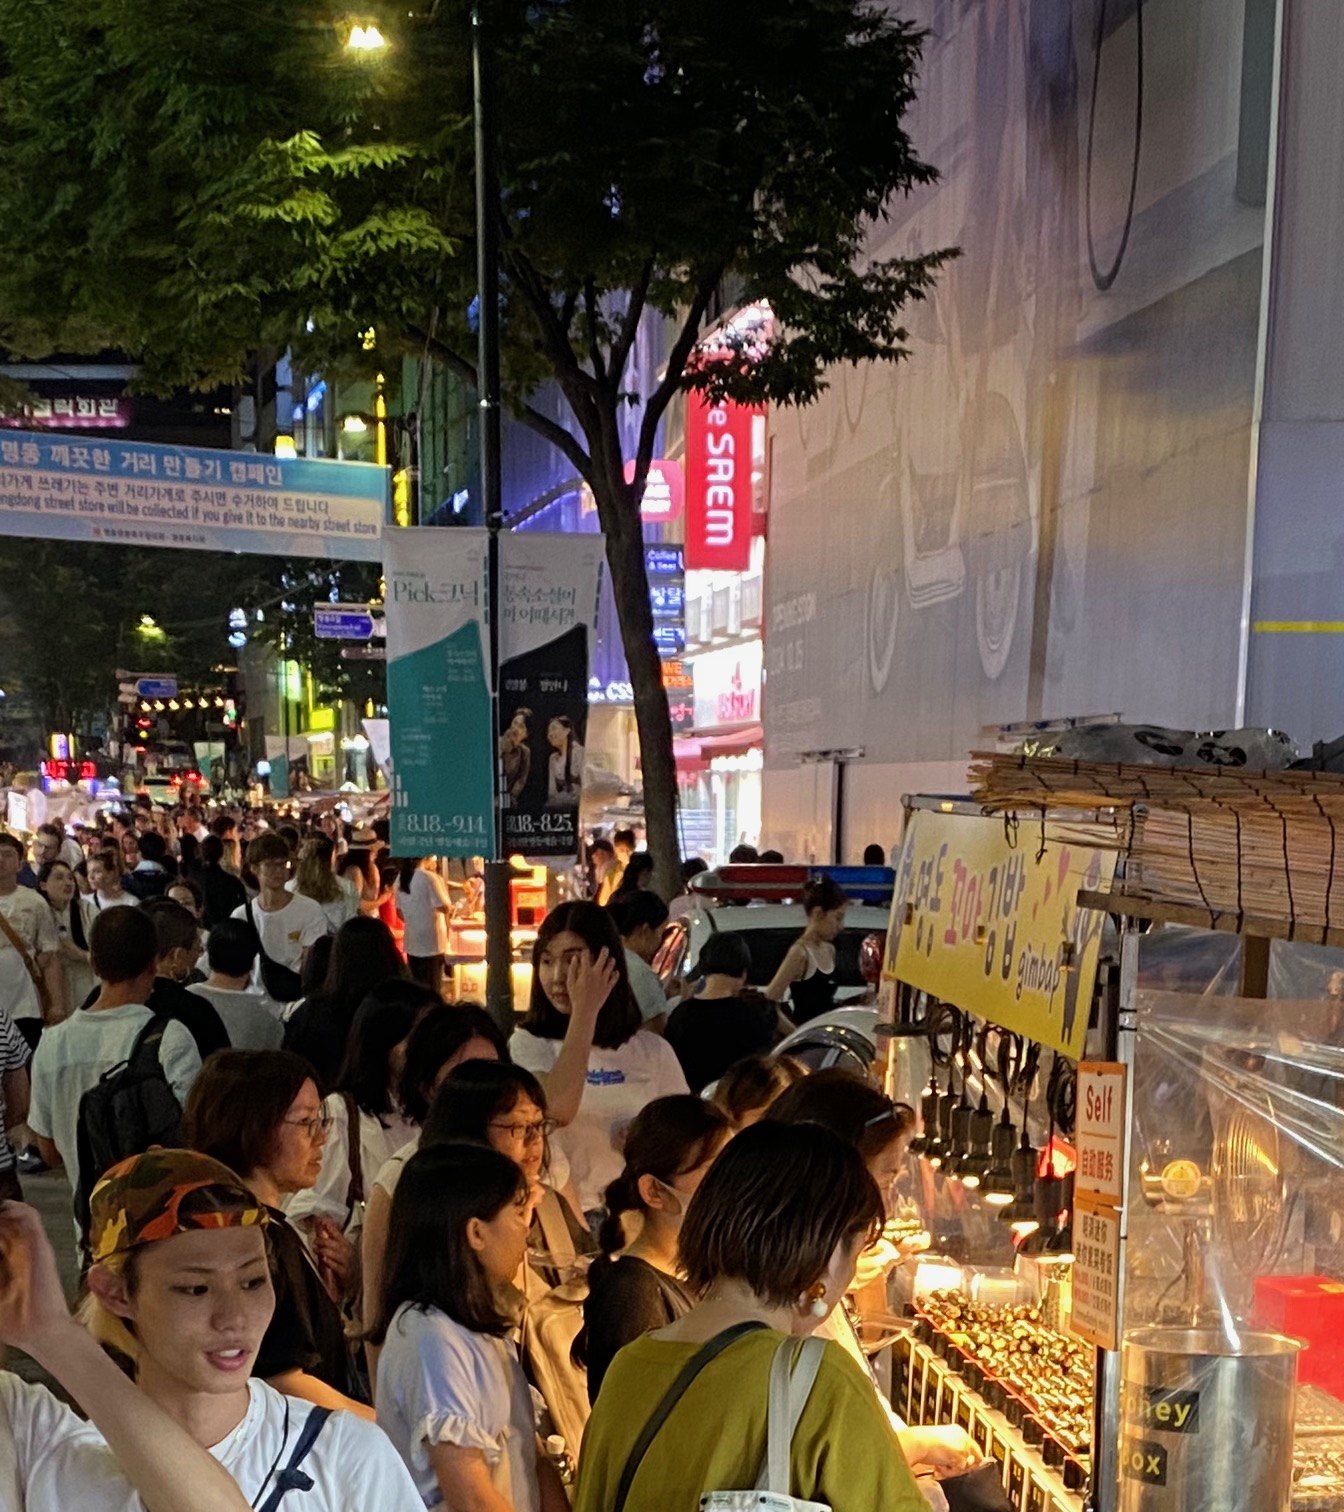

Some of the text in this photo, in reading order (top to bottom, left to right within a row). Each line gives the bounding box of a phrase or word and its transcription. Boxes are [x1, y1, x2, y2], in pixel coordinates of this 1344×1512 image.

[0, 440, 283, 486] 명동 깨끗한 거리 만들기 캠페인
[44, 495, 74, 512] street
[78, 498, 105, 513] store
[141, 504, 189, 520] collected
[202, 510, 220, 524] you
[222, 509, 243, 525] give
[269, 513, 285, 527] the
[288, 516, 321, 536] nearby
[323, 518, 351, 533] street
[353, 519, 377, 535] store
[1015, 942, 1061, 1014] gimbap
[1086, 1084, 1113, 1123] Self
[1081, 1147, 1114, 1183] 自助服务
[1122, 1394, 1192, 1428] oney
